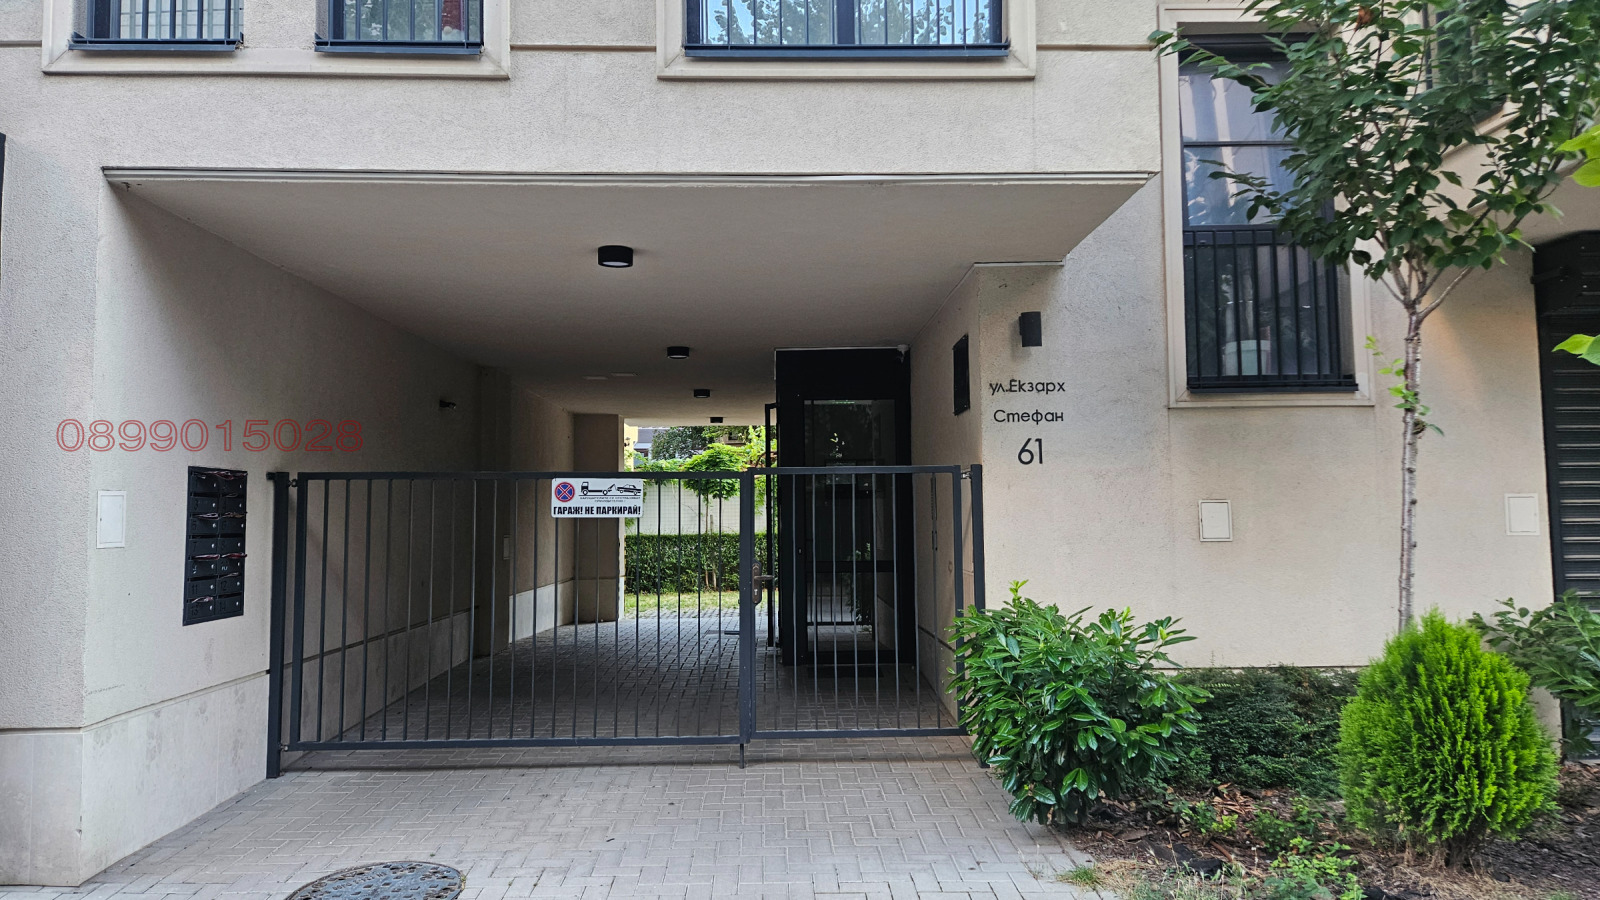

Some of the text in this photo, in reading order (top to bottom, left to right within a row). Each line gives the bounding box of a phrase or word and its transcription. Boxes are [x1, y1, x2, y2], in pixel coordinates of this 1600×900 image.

[993, 409, 1064, 425] Стефан
[1017, 437, 1043, 465] 61
[553, 505, 641, 515] ГАРАЖ! НЕ ПАРКИРАЙ!
